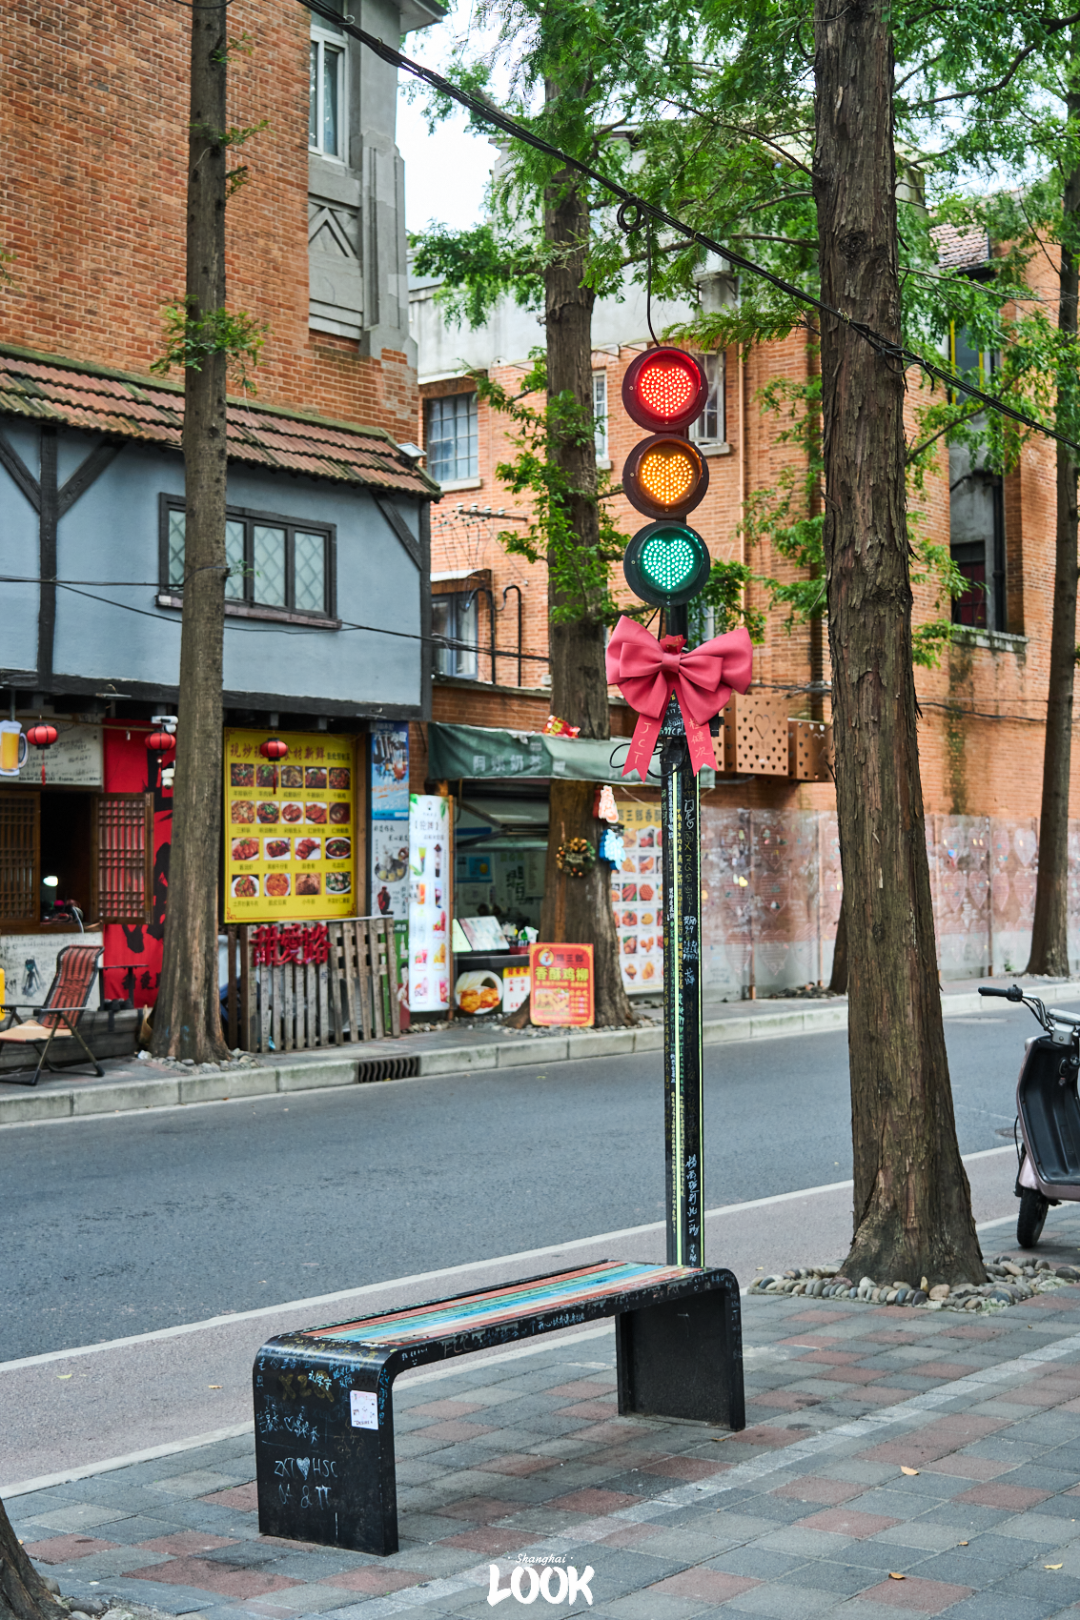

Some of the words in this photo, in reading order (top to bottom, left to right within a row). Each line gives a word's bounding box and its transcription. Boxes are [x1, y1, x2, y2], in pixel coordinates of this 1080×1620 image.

[535, 966, 589, 981] 香酥鸡柳
[312, 1458, 338, 1478] HSC
